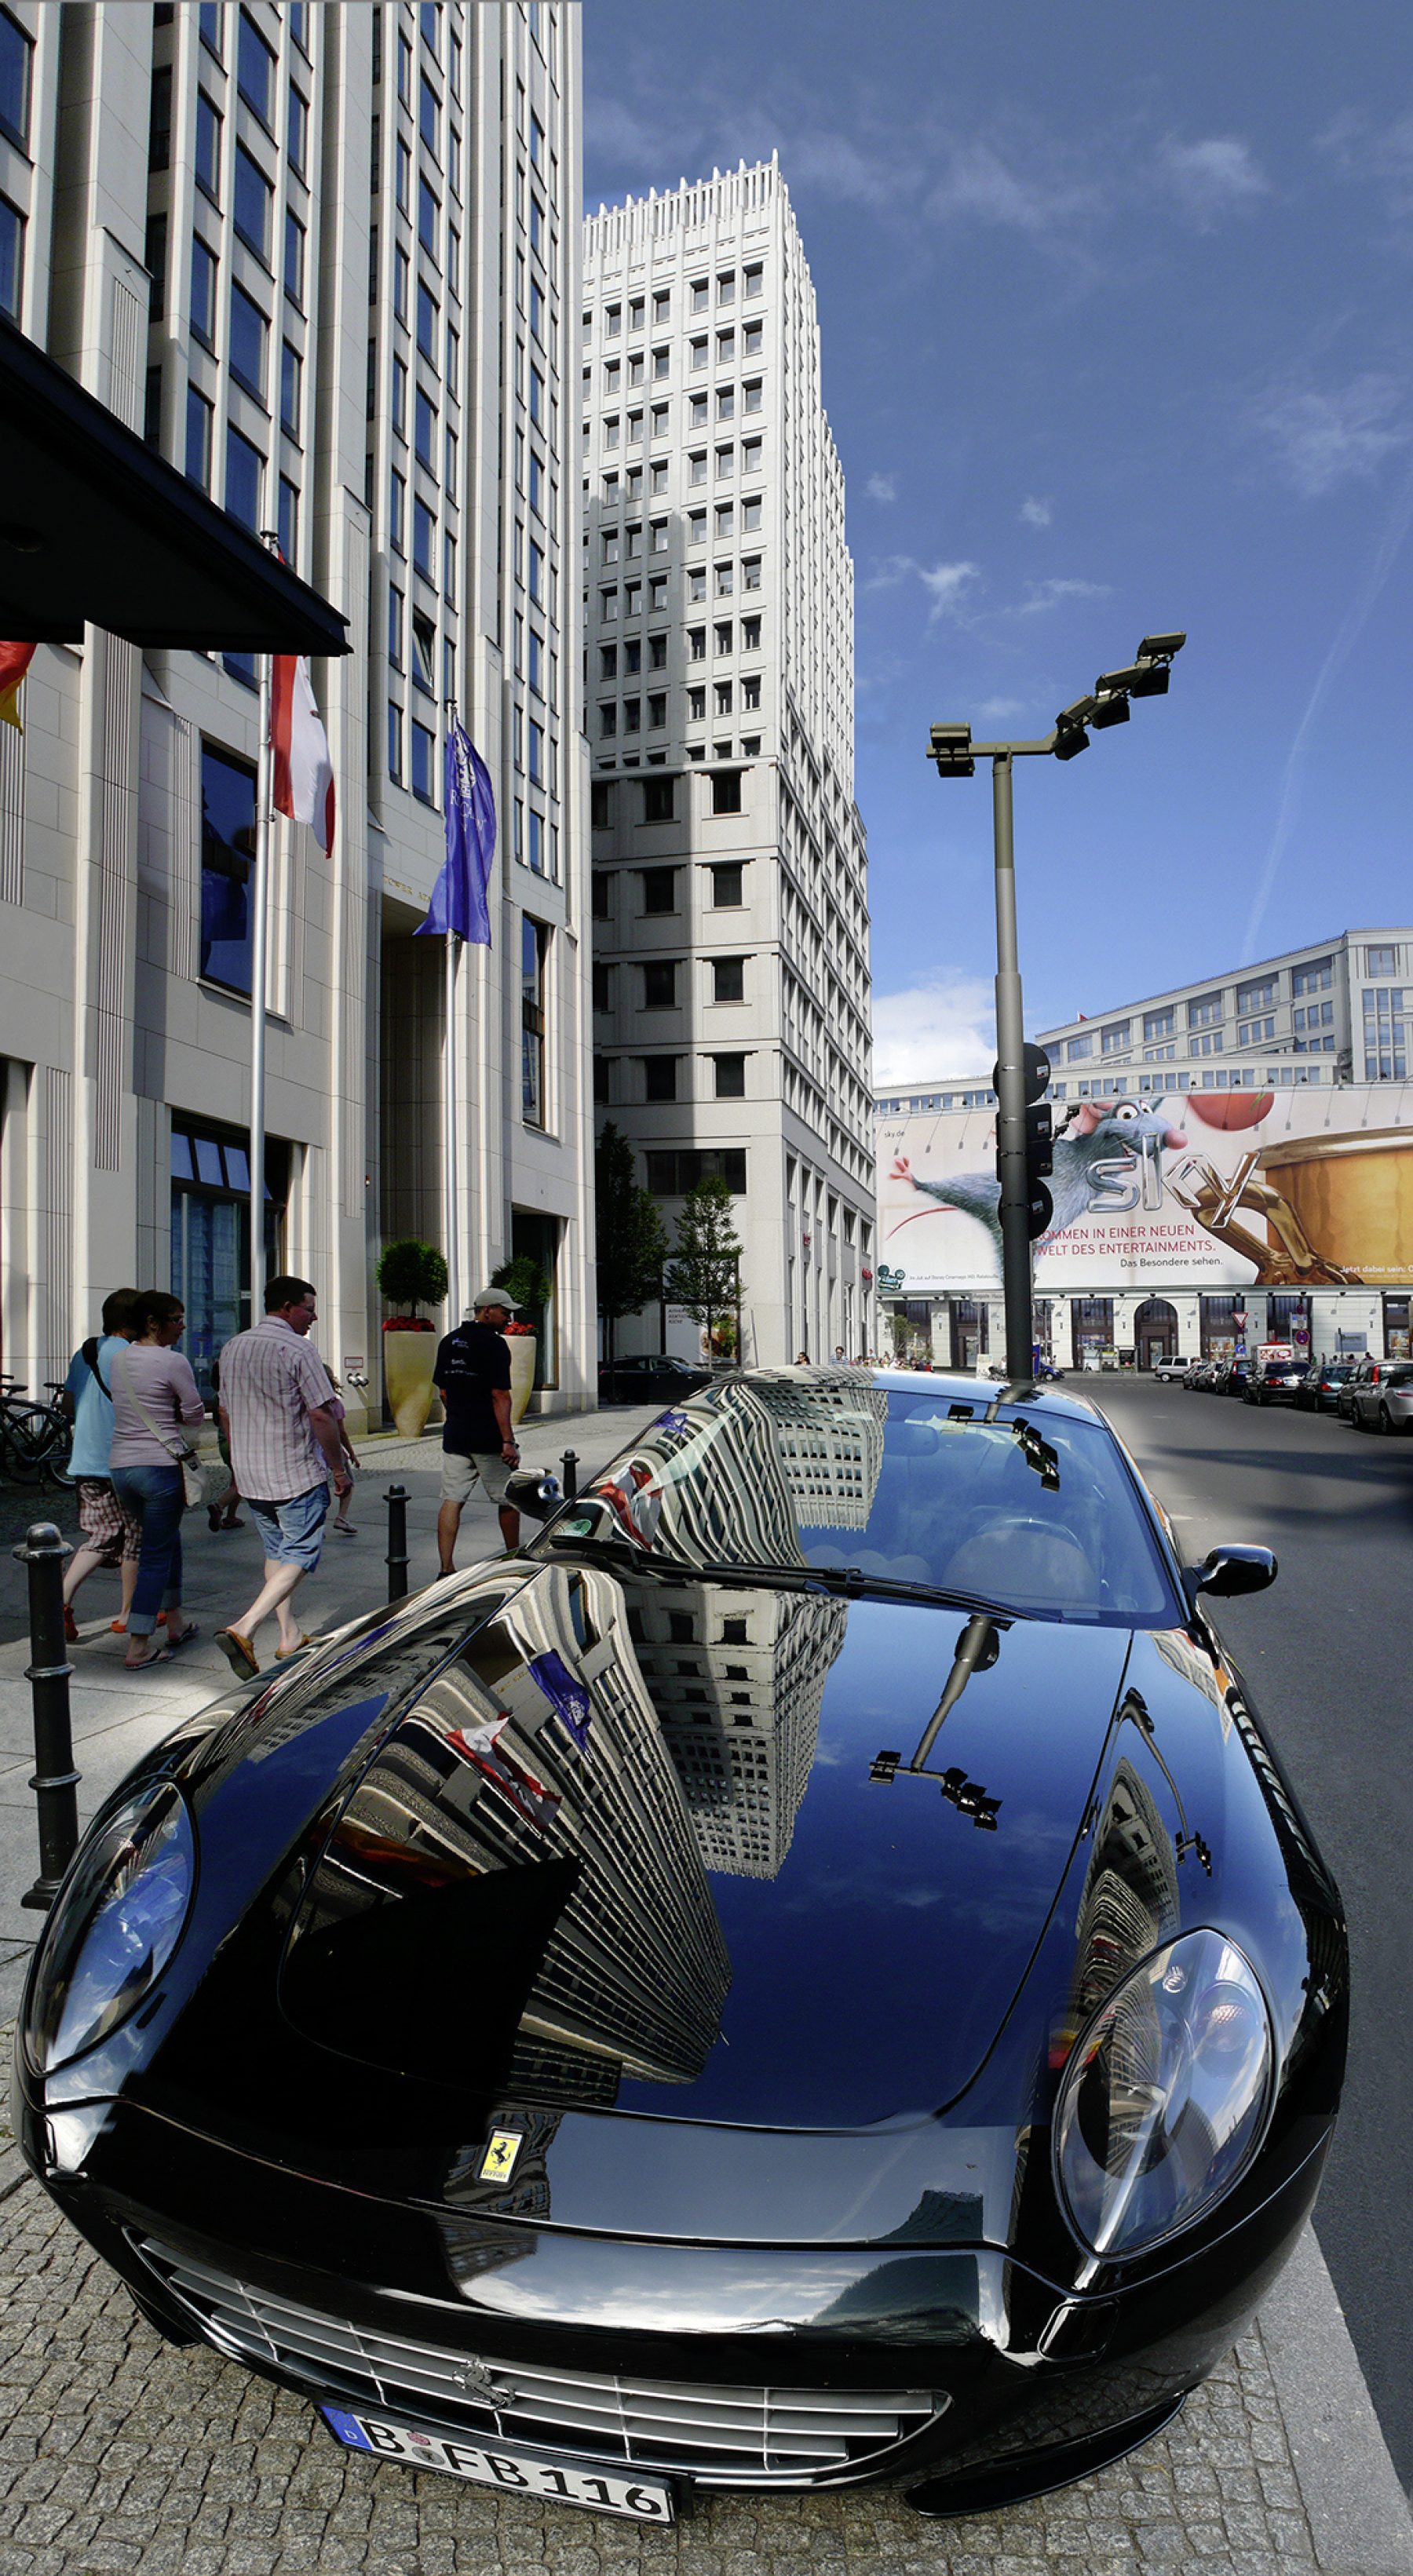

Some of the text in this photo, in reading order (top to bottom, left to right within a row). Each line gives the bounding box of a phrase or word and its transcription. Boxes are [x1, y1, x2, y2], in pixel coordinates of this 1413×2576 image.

[1086, 1131, 1261, 1228] sky
[1093, 1228, 1105, 1239] IN
[1109, 1226, 1146, 1239] EINER
[1149, 1224, 1195, 1237] NEUEN
[1035, 1240, 1217, 1256] WELT DES ENTERTAINMENTS.
[1120, 1257, 1223, 1268] Das Besondere sehen.
[360, 2419, 663, 2515] B FB 116
